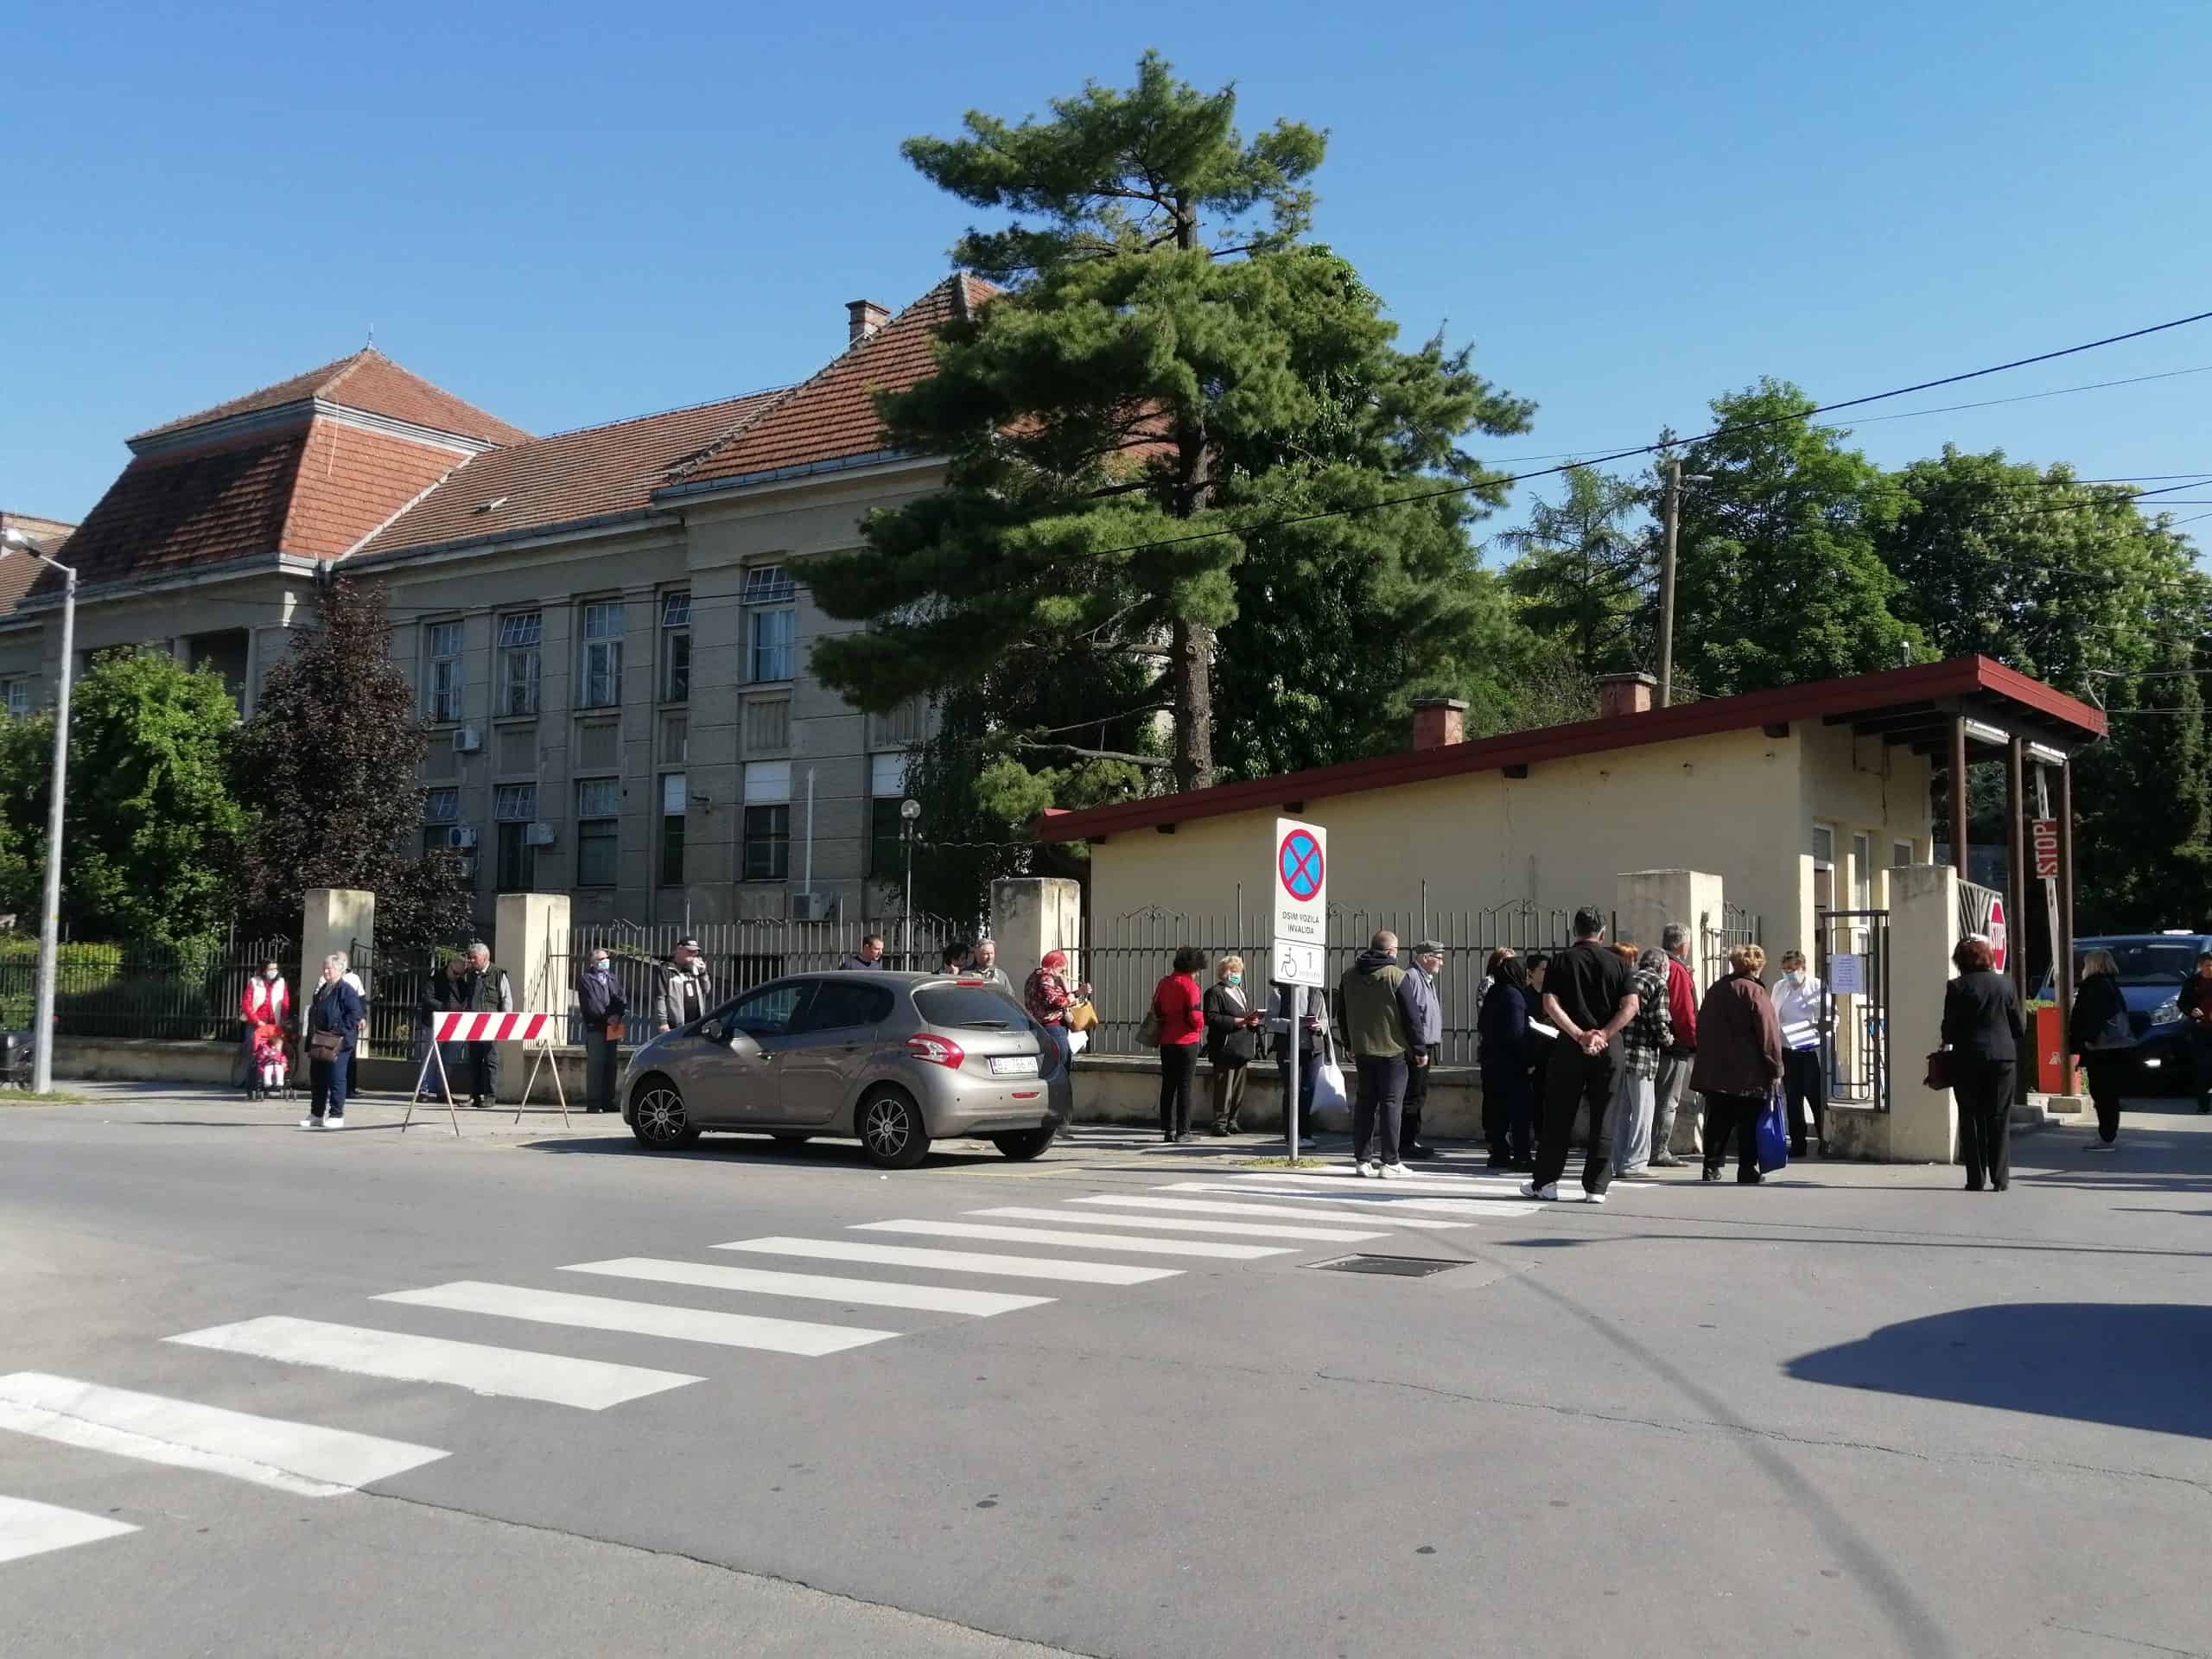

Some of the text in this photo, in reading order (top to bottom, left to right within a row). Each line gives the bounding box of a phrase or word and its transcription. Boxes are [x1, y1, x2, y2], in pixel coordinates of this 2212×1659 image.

[2033, 823, 2058, 873] STOP
[1282, 912, 1319, 924] OSIM VOZILA
[1288, 925, 1314, 934] INVALIDA
[1990, 922, 2005, 950] STOP
[1306, 951, 1313, 969] 1
